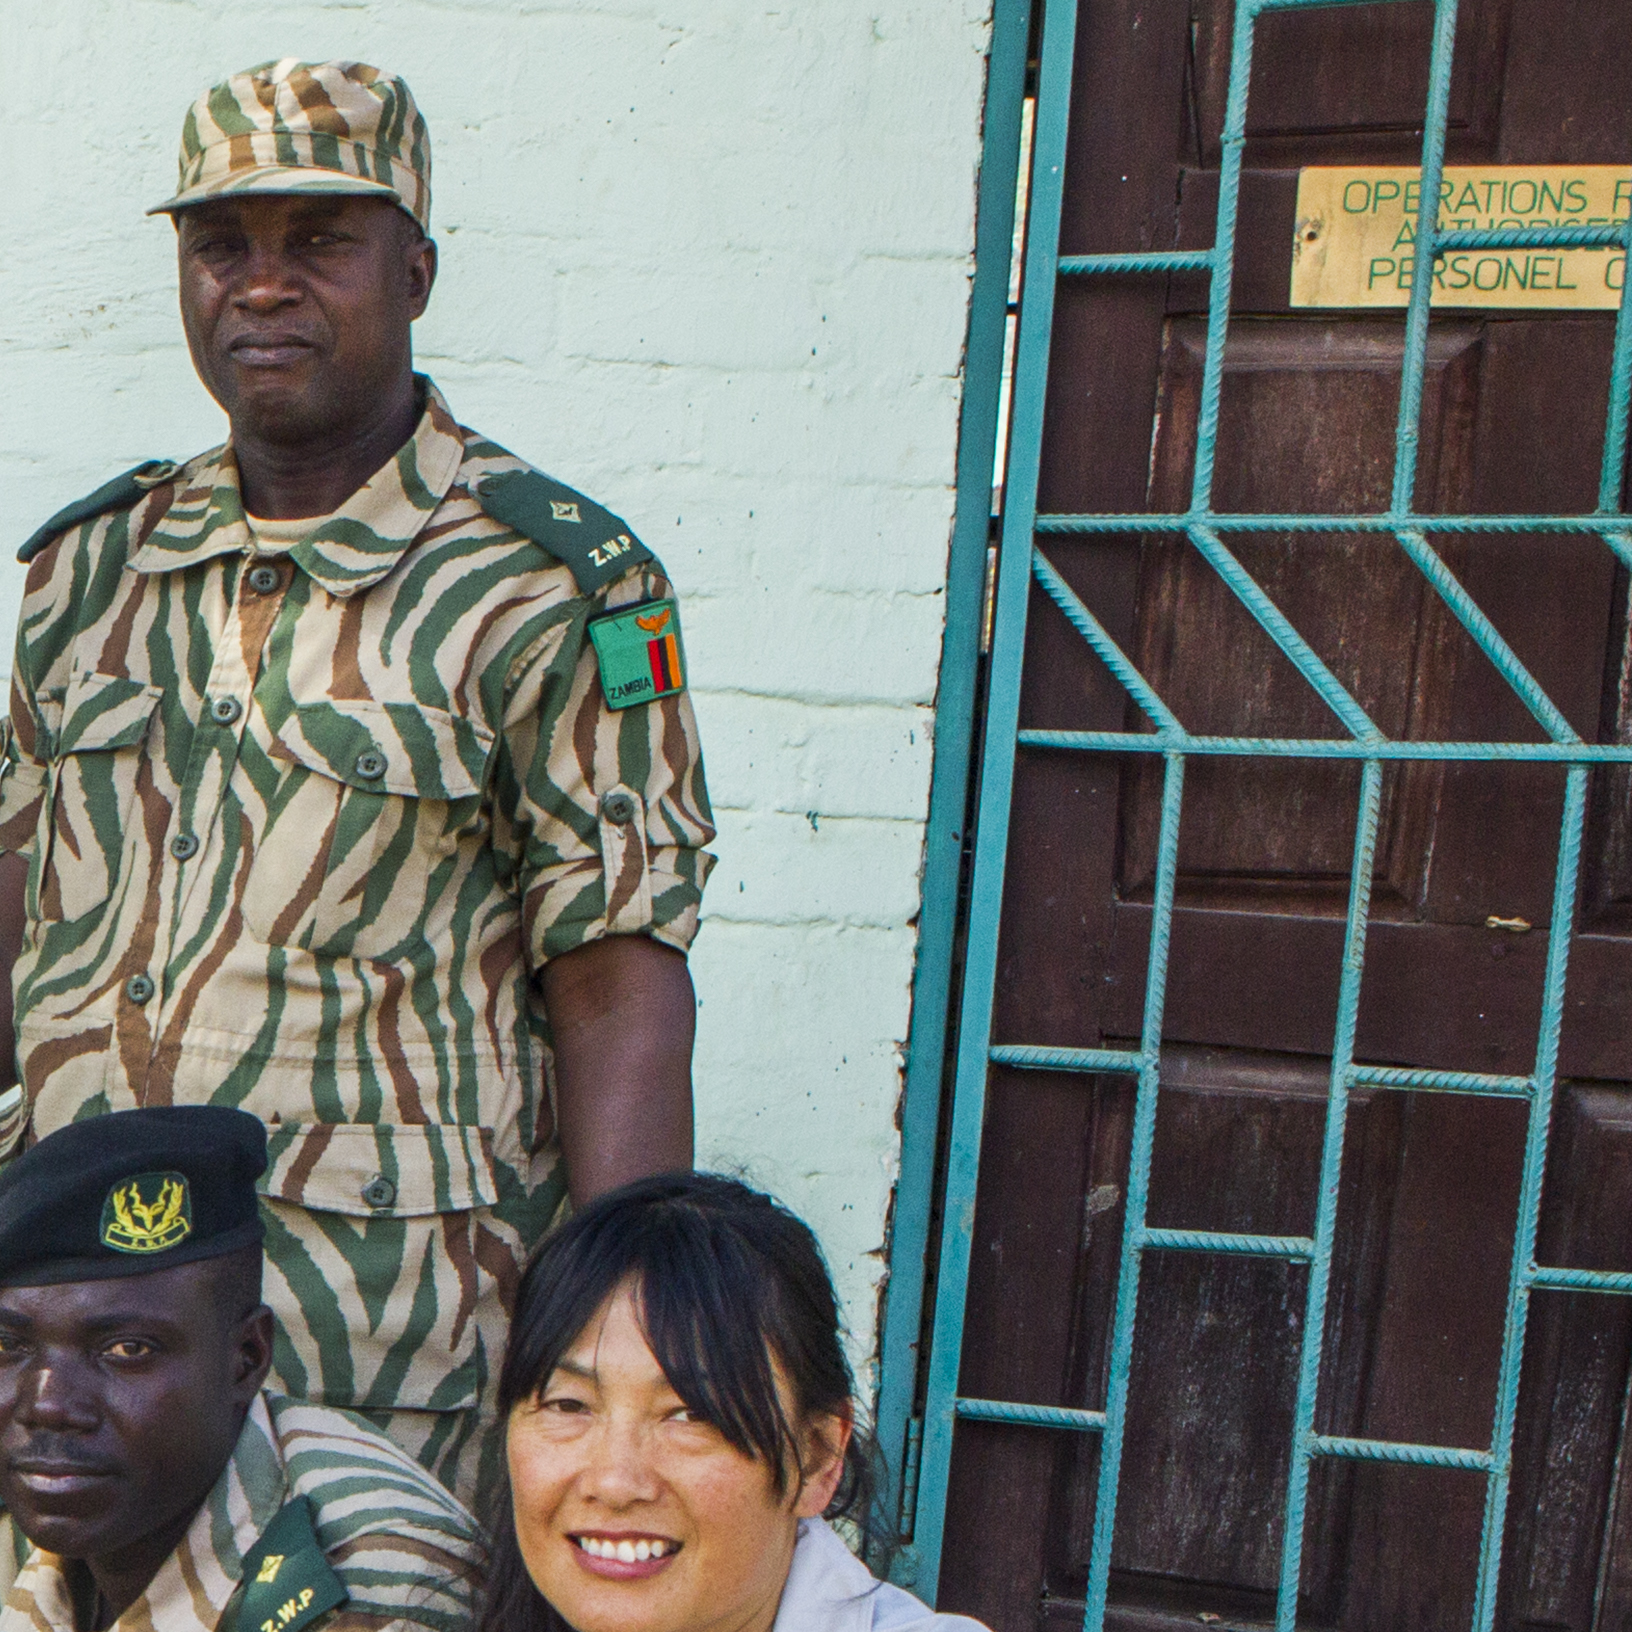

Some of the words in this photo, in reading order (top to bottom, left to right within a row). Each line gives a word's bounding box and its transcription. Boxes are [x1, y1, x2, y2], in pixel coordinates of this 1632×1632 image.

[1342, 179, 1588, 214] OPERATIONS
[1368, 255, 1577, 291] PERSONEL
[609, 676, 652, 700] ZAMBIA
